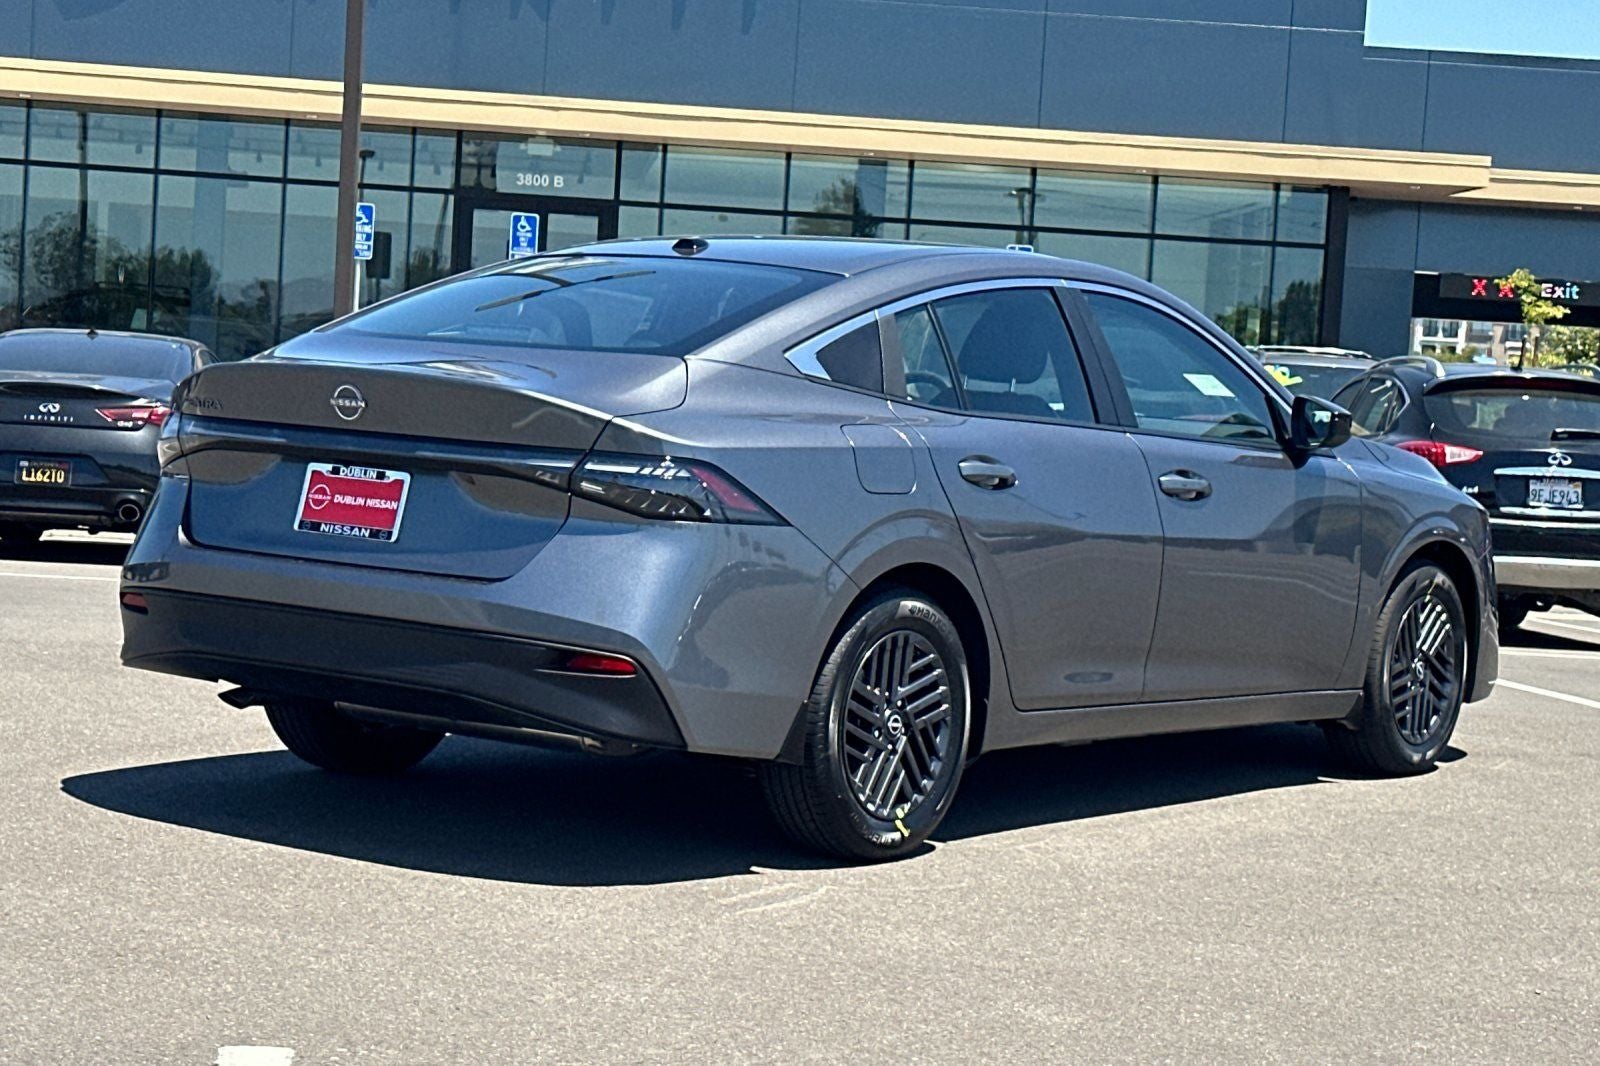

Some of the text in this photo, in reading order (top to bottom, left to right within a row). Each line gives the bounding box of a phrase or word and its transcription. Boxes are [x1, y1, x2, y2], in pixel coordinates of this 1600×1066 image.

[516, 173, 564, 188] 3800 B
[1541, 282, 1580, 300] Exit
[330, 398, 366, 408] NISSAN
[23, 414, 74, 423] INFINITI
[340, 467, 377, 479] DUBLIN
[333, 494, 398, 510] DUBLIN NISSAN
[320, 523, 370, 538] NISSAN
